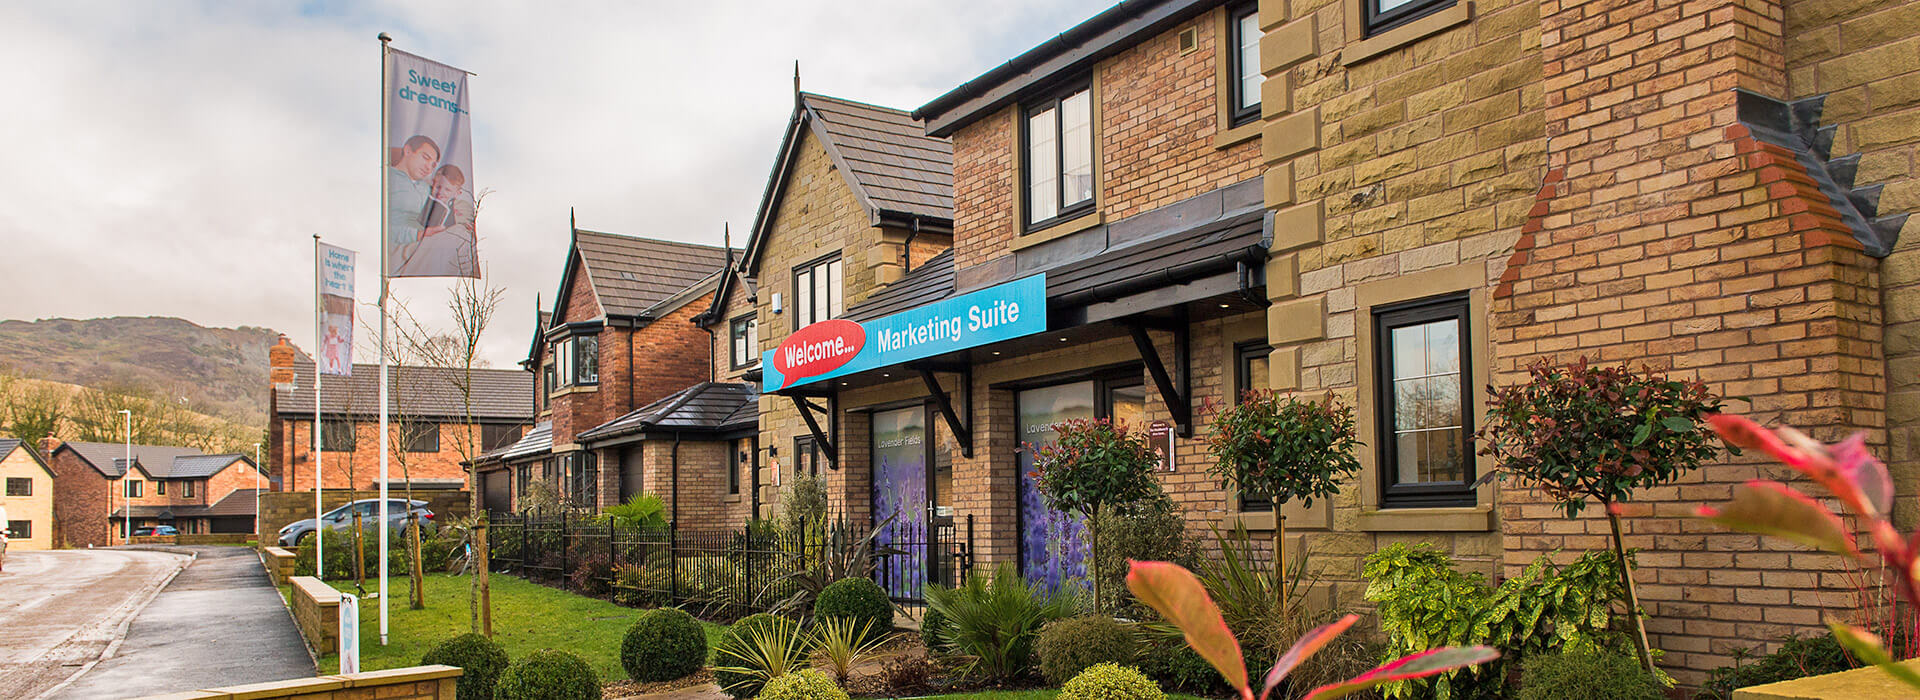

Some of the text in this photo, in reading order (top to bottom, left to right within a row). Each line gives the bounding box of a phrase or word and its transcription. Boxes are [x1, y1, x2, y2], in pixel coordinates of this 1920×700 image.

[408, 69, 456, 95] Sweet
[399, 85, 469, 115] dreams...
[328, 248, 349, 262] Home
[325, 257, 331, 267] is
[334, 271, 346, 280] the
[325, 278, 346, 290] heart
[785, 300, 1020, 369] Welcome... Marketing Suite
[878, 438, 903, 449] Lavender
